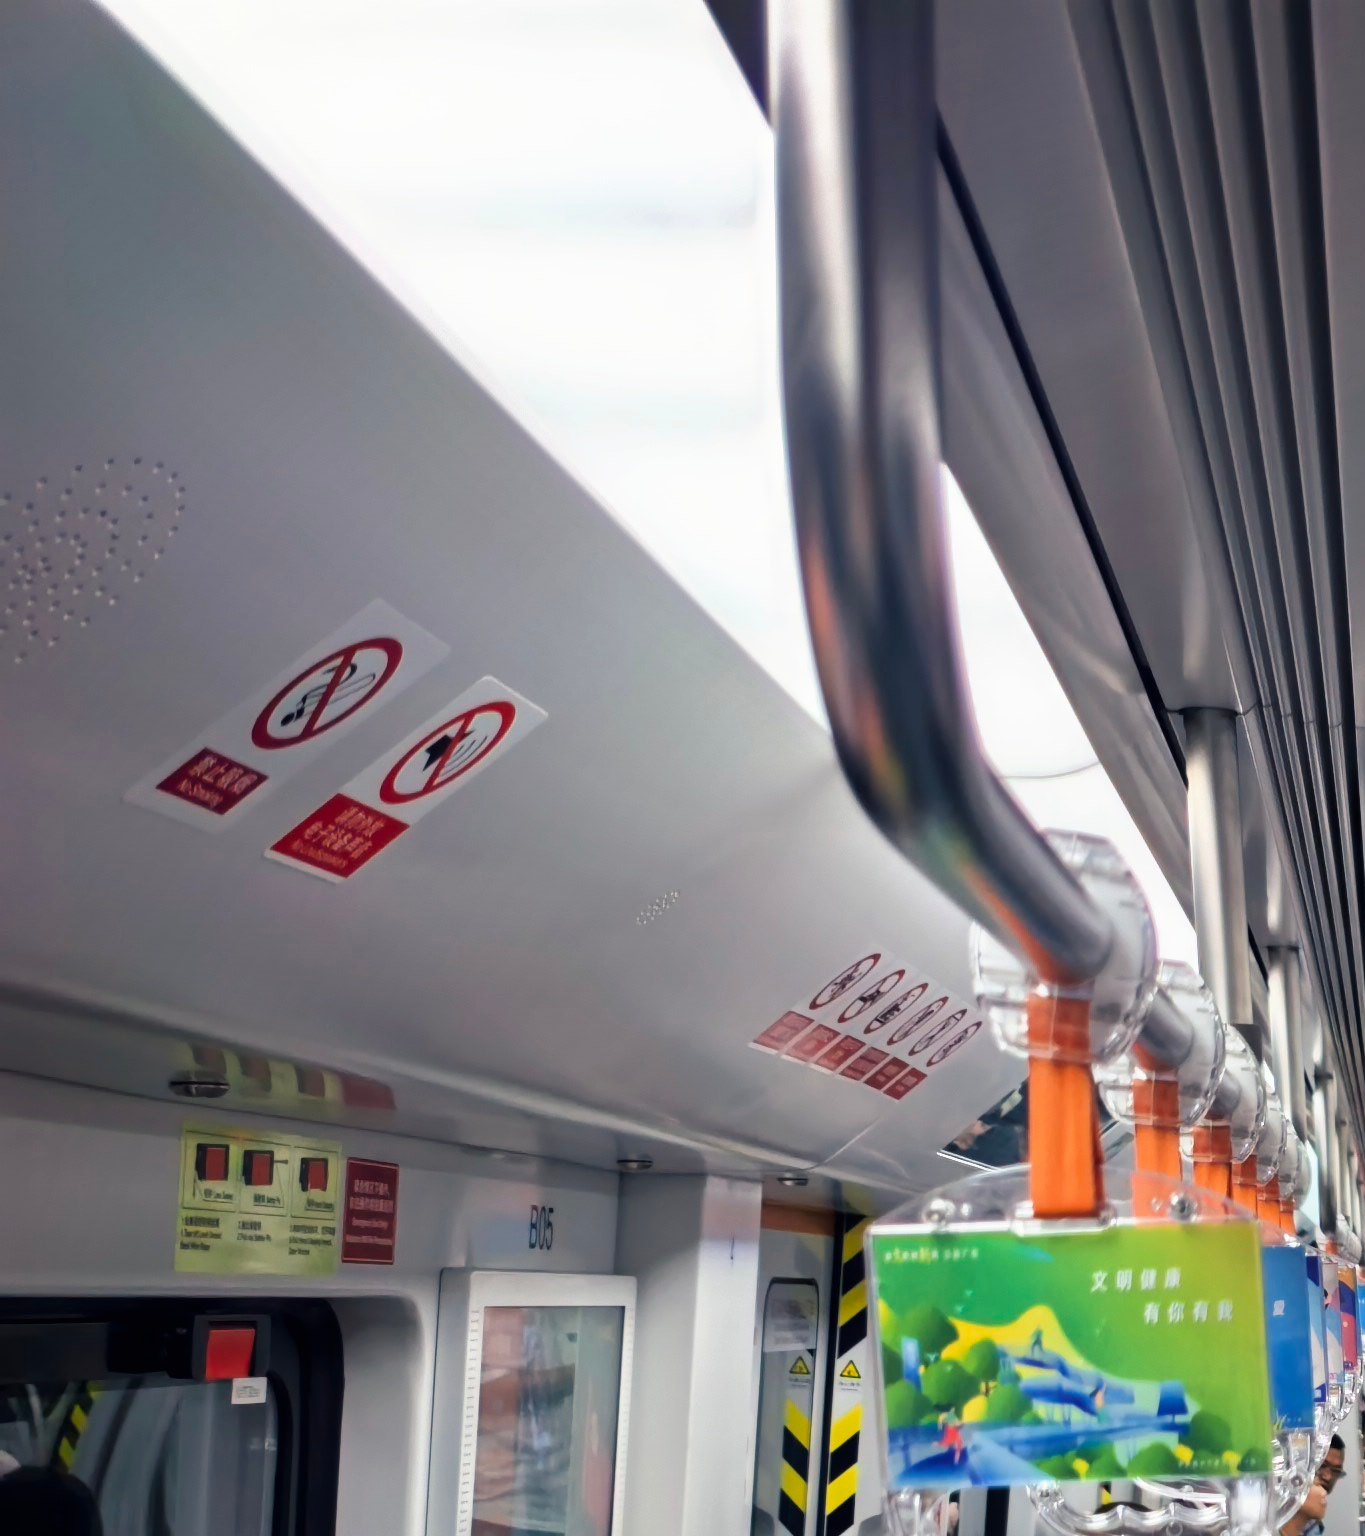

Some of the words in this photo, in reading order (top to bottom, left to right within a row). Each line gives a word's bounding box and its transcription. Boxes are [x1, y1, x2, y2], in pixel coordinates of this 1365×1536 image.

[528, 1204, 555, 1251] B05
[1090, 1266, 1183, 1294] 文明健康
[1143, 1299, 1234, 1325] 有你有我
